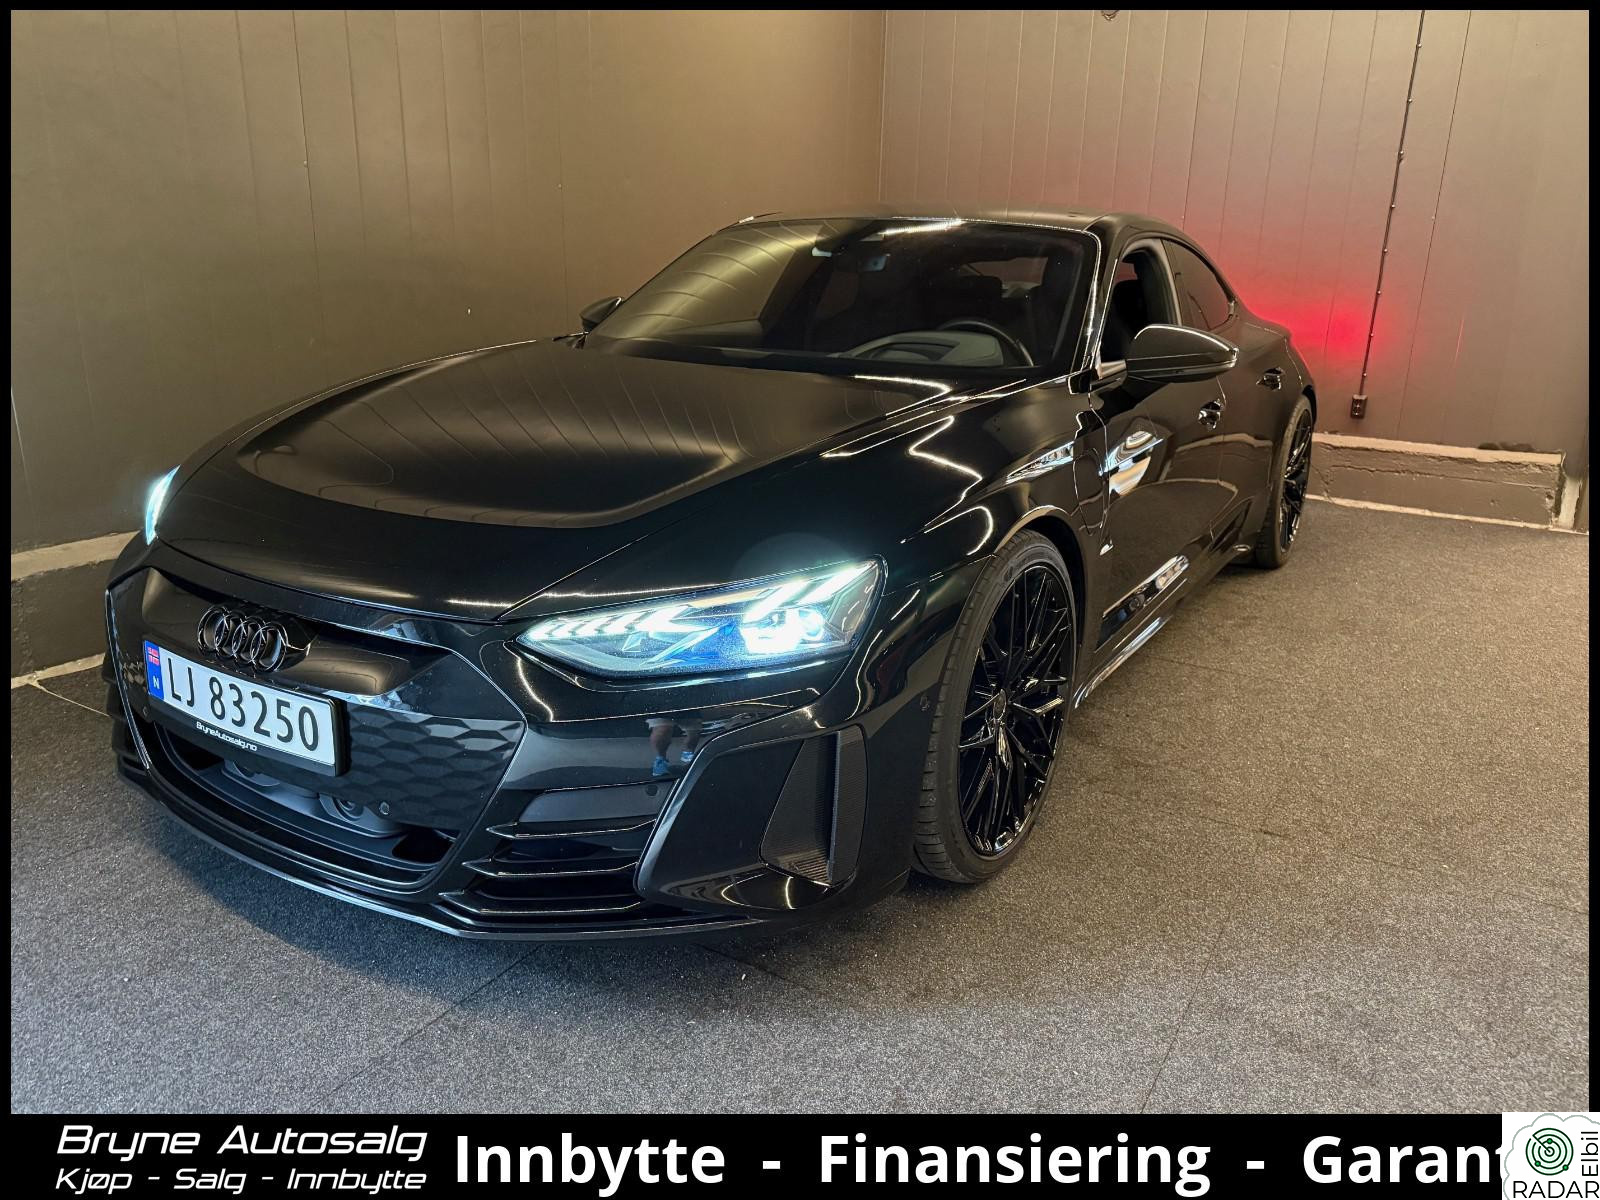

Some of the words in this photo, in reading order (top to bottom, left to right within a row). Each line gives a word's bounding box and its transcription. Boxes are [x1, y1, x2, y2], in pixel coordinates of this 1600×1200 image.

[153, 674, 160, 690] N
[167, 658, 195, 707] LJ
[208, 676, 319, 752] 83250
